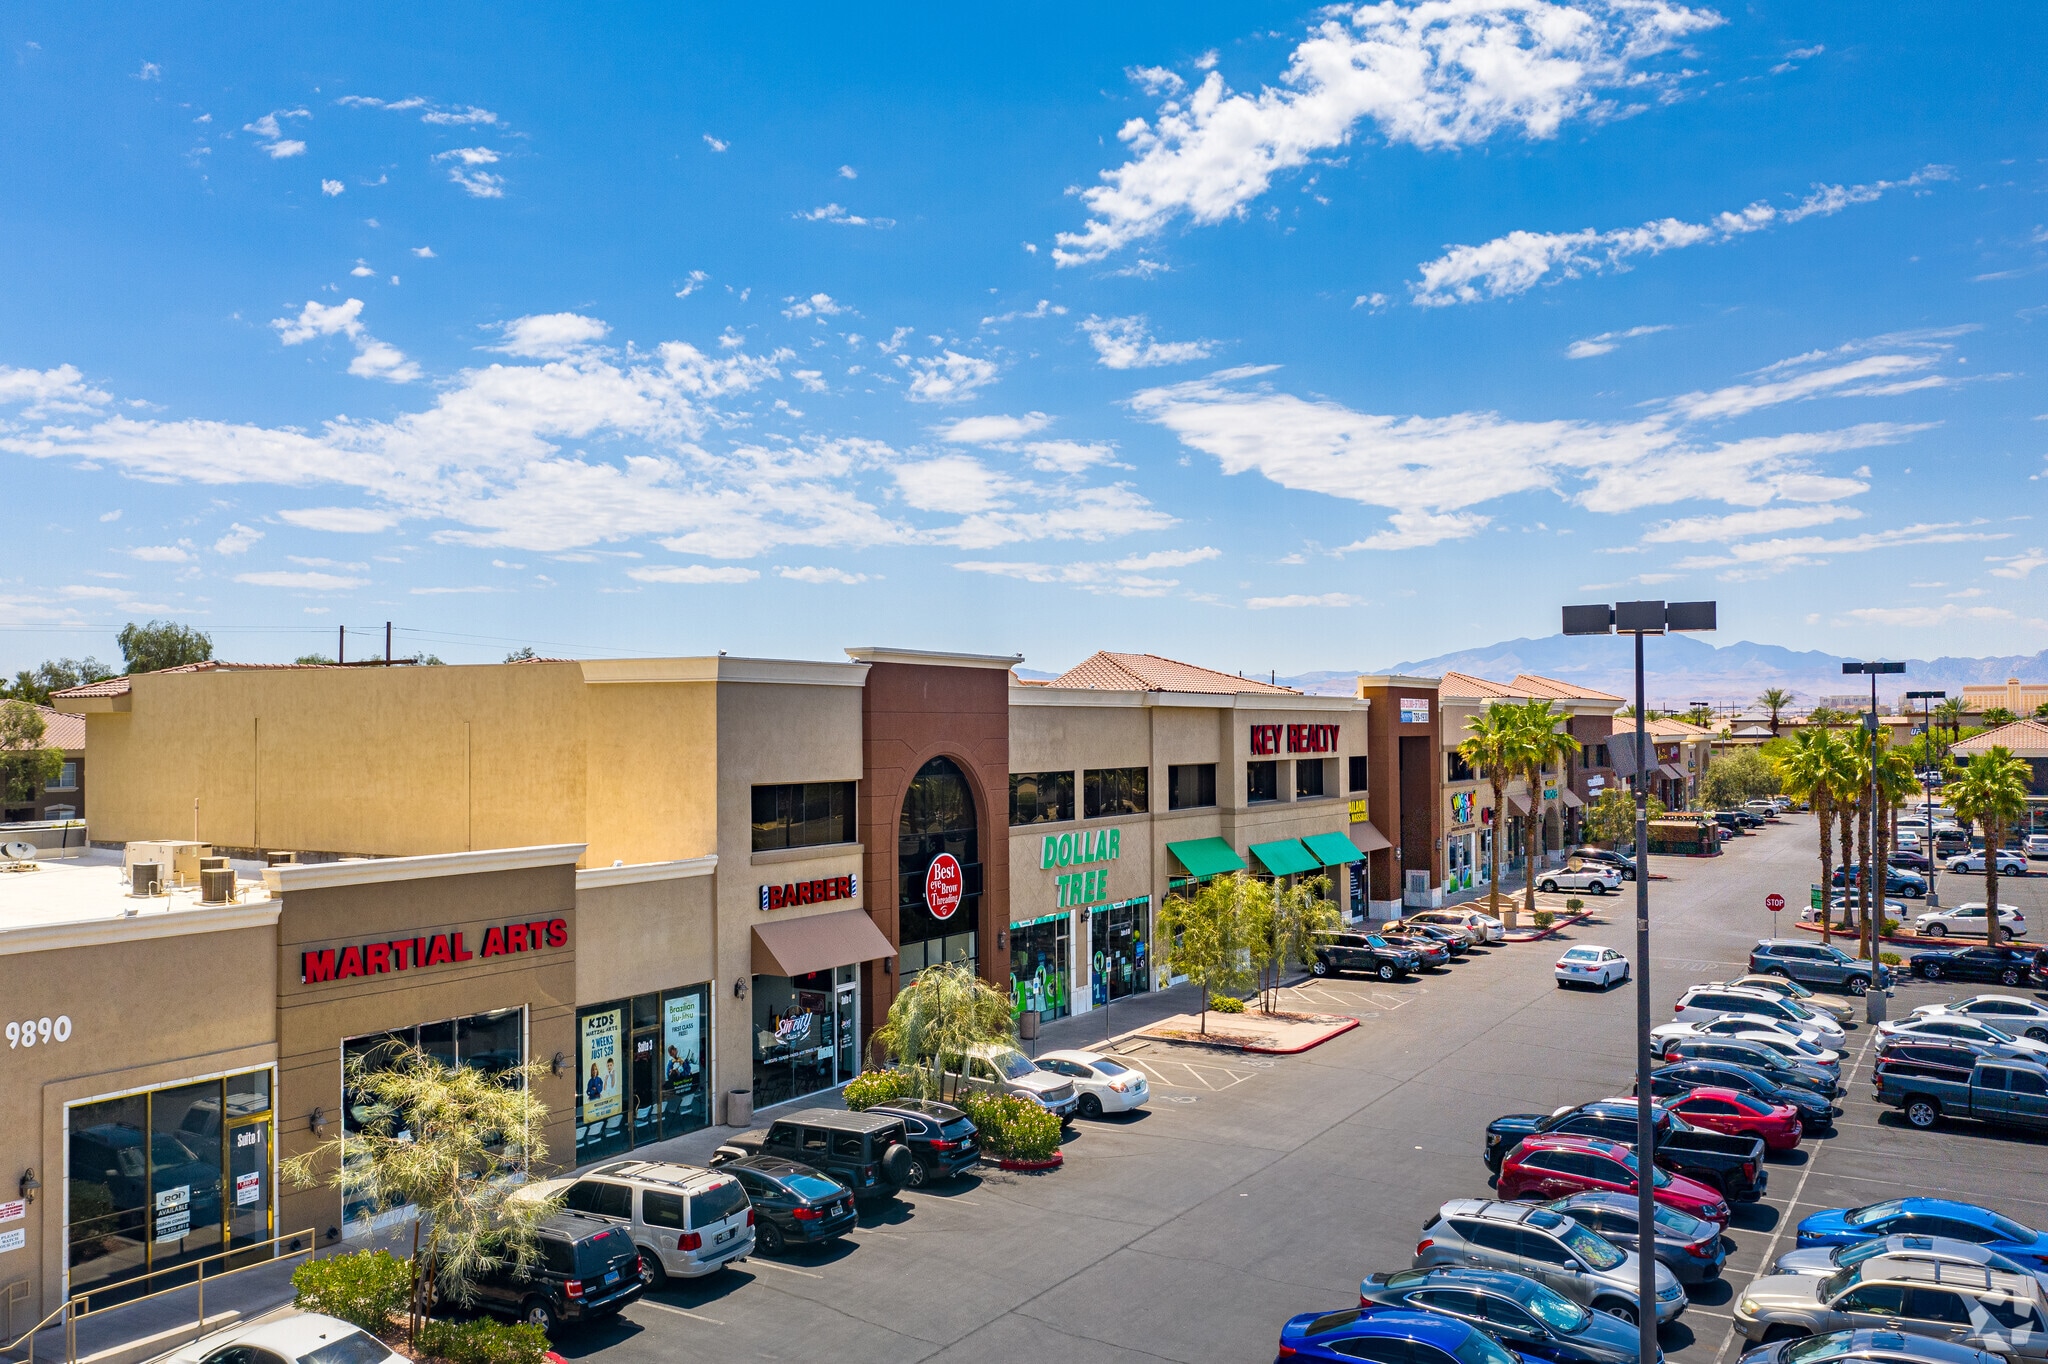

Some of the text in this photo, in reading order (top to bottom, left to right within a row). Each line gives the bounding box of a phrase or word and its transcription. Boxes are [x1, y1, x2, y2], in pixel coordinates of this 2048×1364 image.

[1250, 724, 1340, 755] KEY REALTY
[1040, 828, 1121, 870] DOLLAR
[934, 863, 955, 881] Best
[931, 880, 942, 892] eye
[941, 883, 959, 895] Brow
[1055, 868, 1109, 909] TREE
[768, 876, 851, 911] BARBER
[931, 893, 959, 906] Threading
[1766, 898, 1784, 907] STOP
[301, 918, 569, 985] MARTIAL ARTS
[669, 1002, 695, 1013] Brazilian
[588, 1014, 614, 1029] KIDS
[682, 1023, 694, 1031] CLASS
[5, 1014, 72, 1050] 9890
[591, 1035, 613, 1049] 2 WEEKS
[591, 1049, 603, 1060] JUST
[237, 1130, 260, 1148] Suite 1
[164, 1193, 181, 1203] ROI
[158, 1203, 188, 1217] AVAILABLE
[1, 1232, 19, 1240] PLEASE
[2, 1236, 19, 1244] WATCH
